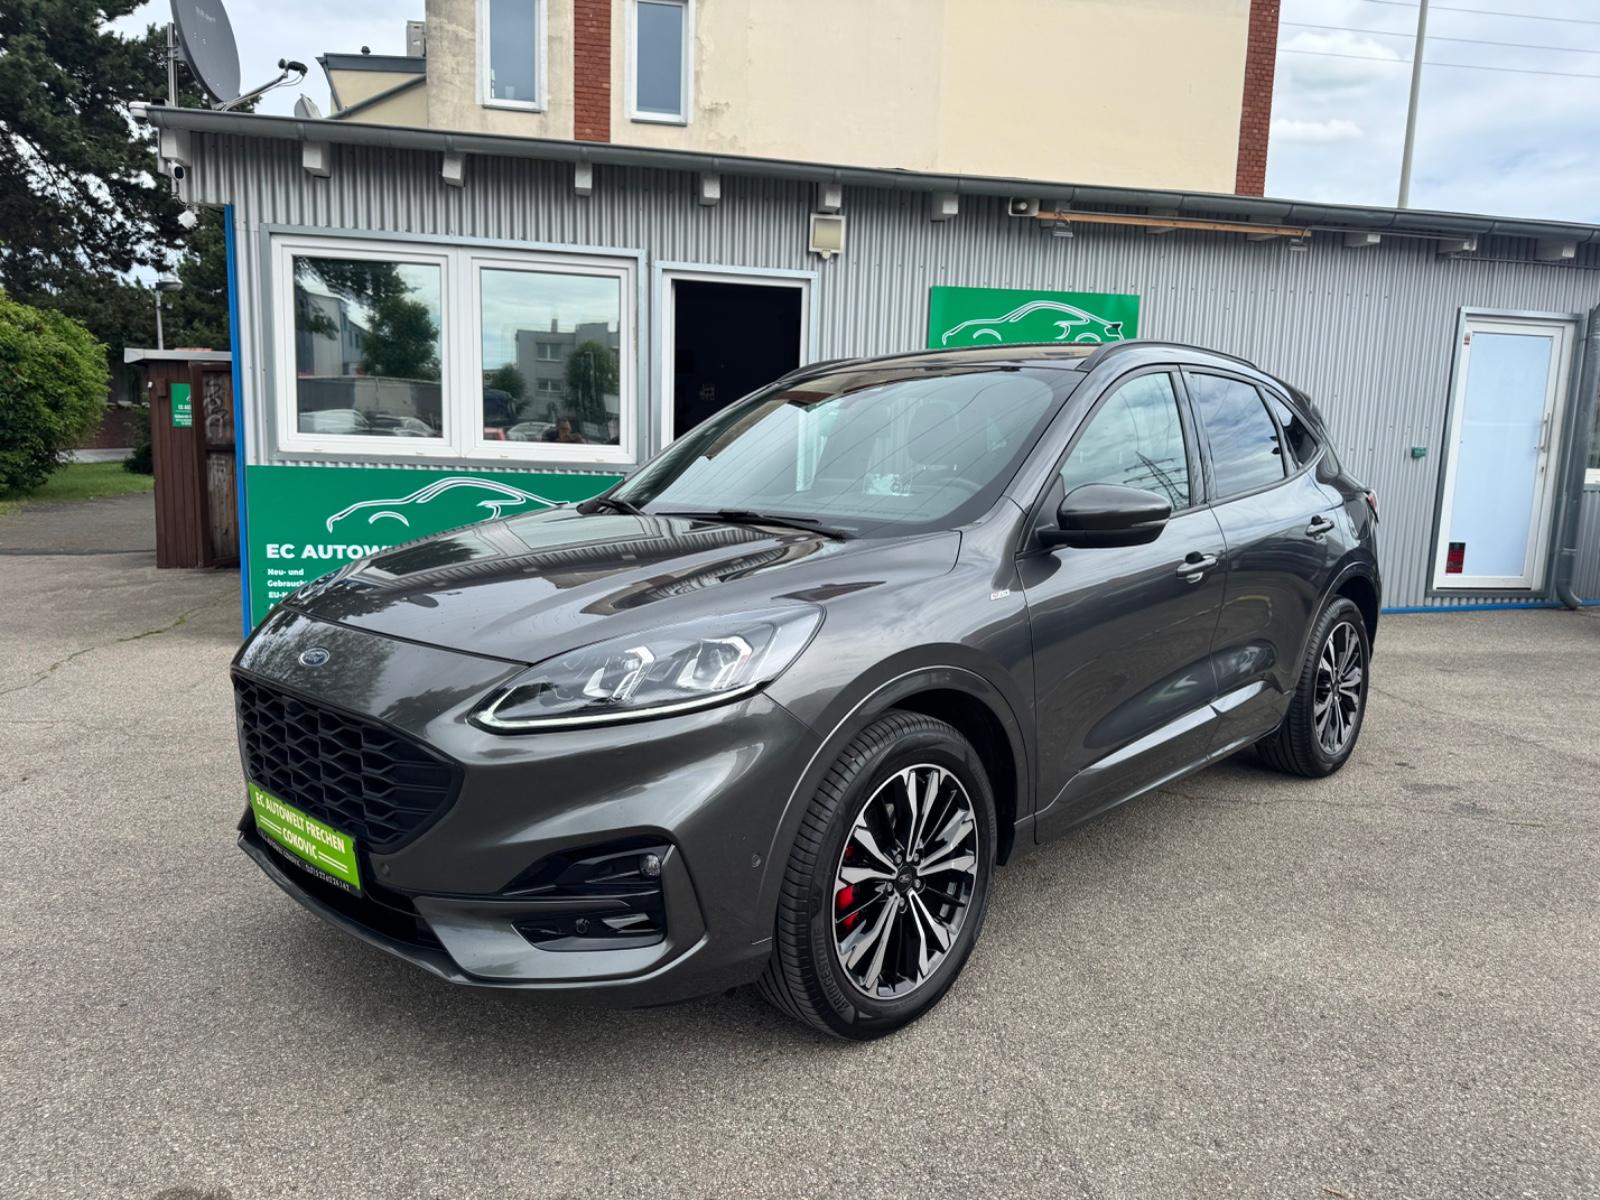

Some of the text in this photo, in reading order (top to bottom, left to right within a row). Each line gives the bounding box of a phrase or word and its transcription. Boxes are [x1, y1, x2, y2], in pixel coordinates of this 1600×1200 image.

[266, 543, 392, 560] EC AUTOW
[267, 568, 305, 576] Neu- und
[267, 579, 308, 588] Gebrauch
[255, 792, 265, 808] EC
[265, 798, 305, 832] AUTOWELT
[305, 820, 345, 854] FRECHEN
